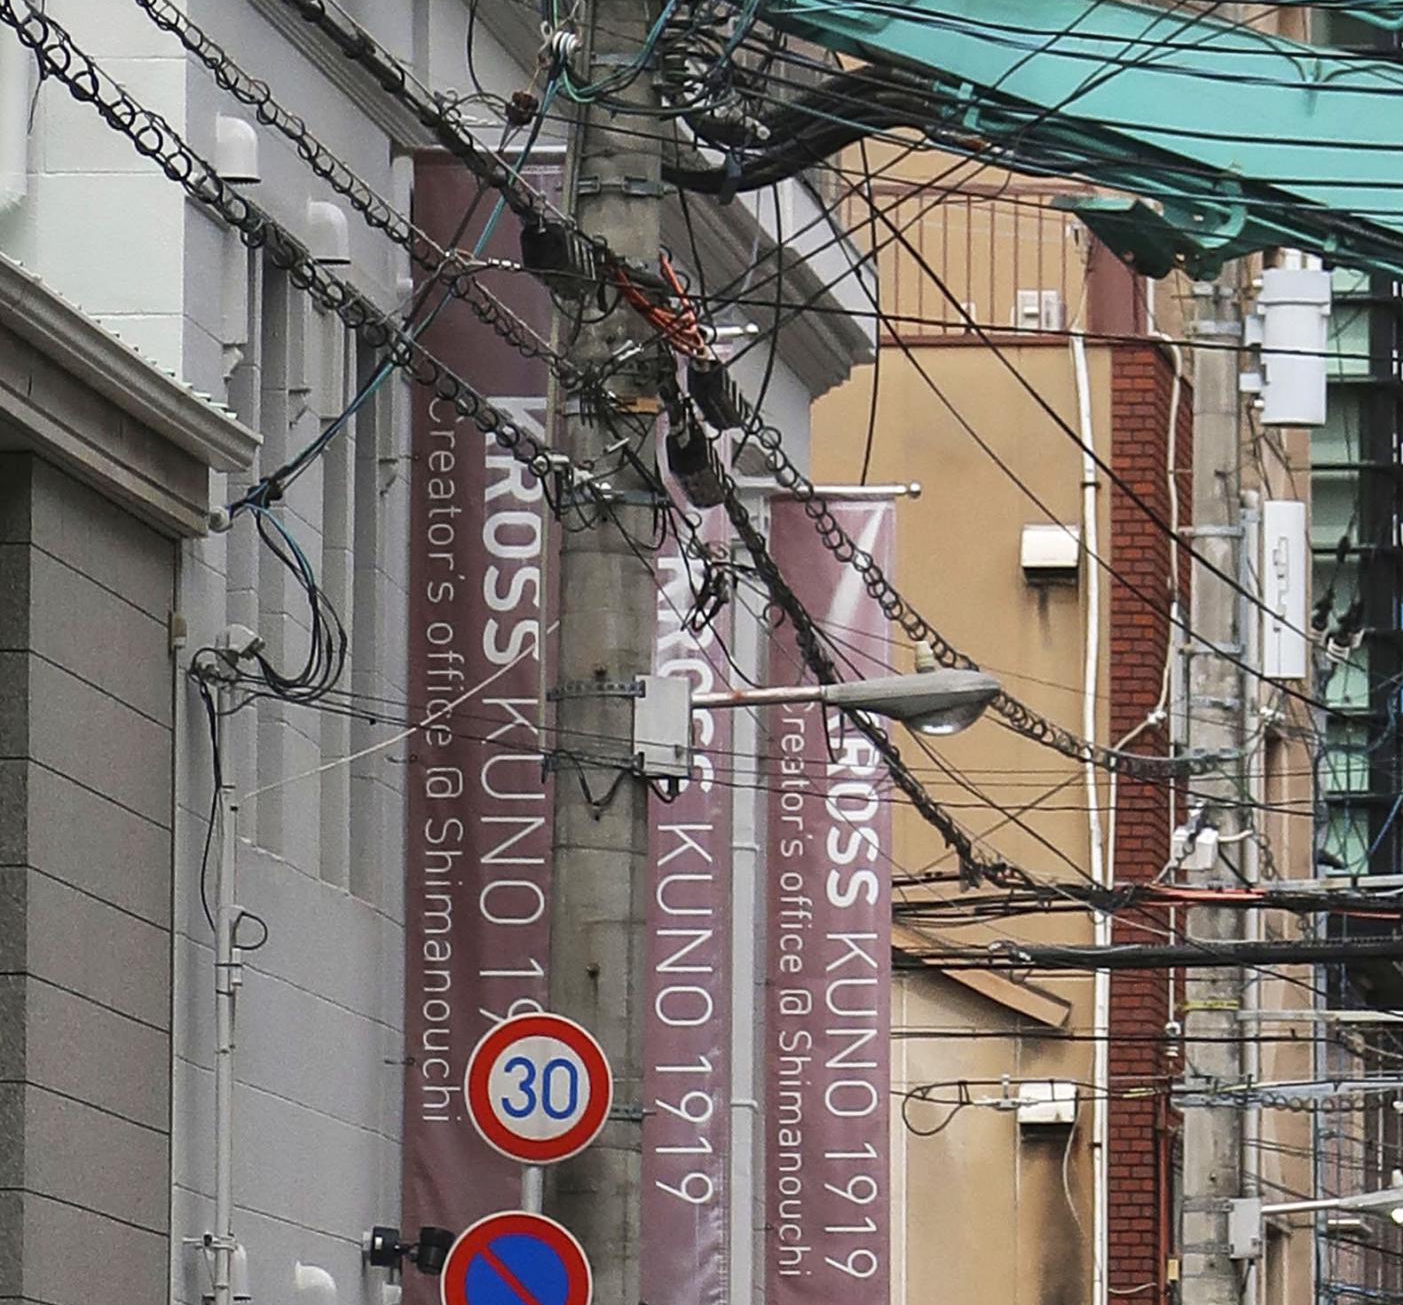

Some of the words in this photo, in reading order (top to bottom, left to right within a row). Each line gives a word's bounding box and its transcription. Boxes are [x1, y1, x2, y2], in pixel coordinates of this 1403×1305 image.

[481, 397, 548, 665] KROSS
[425, 621, 465, 746] office
[480, 698, 546, 925] KUNO
[423, 818, 463, 1123] Shimanouchi
[656, 823, 714, 1027] KUNO
[780, 870, 813, 973] office
[500, 1056, 579, 1120] 30
[824, 932, 879, 1117] KUNO
[654, 1055, 714, 1204] 1919
[777, 1030, 812, 1276] Shimanouchi
[824, 1141, 879, 1278] 1919
